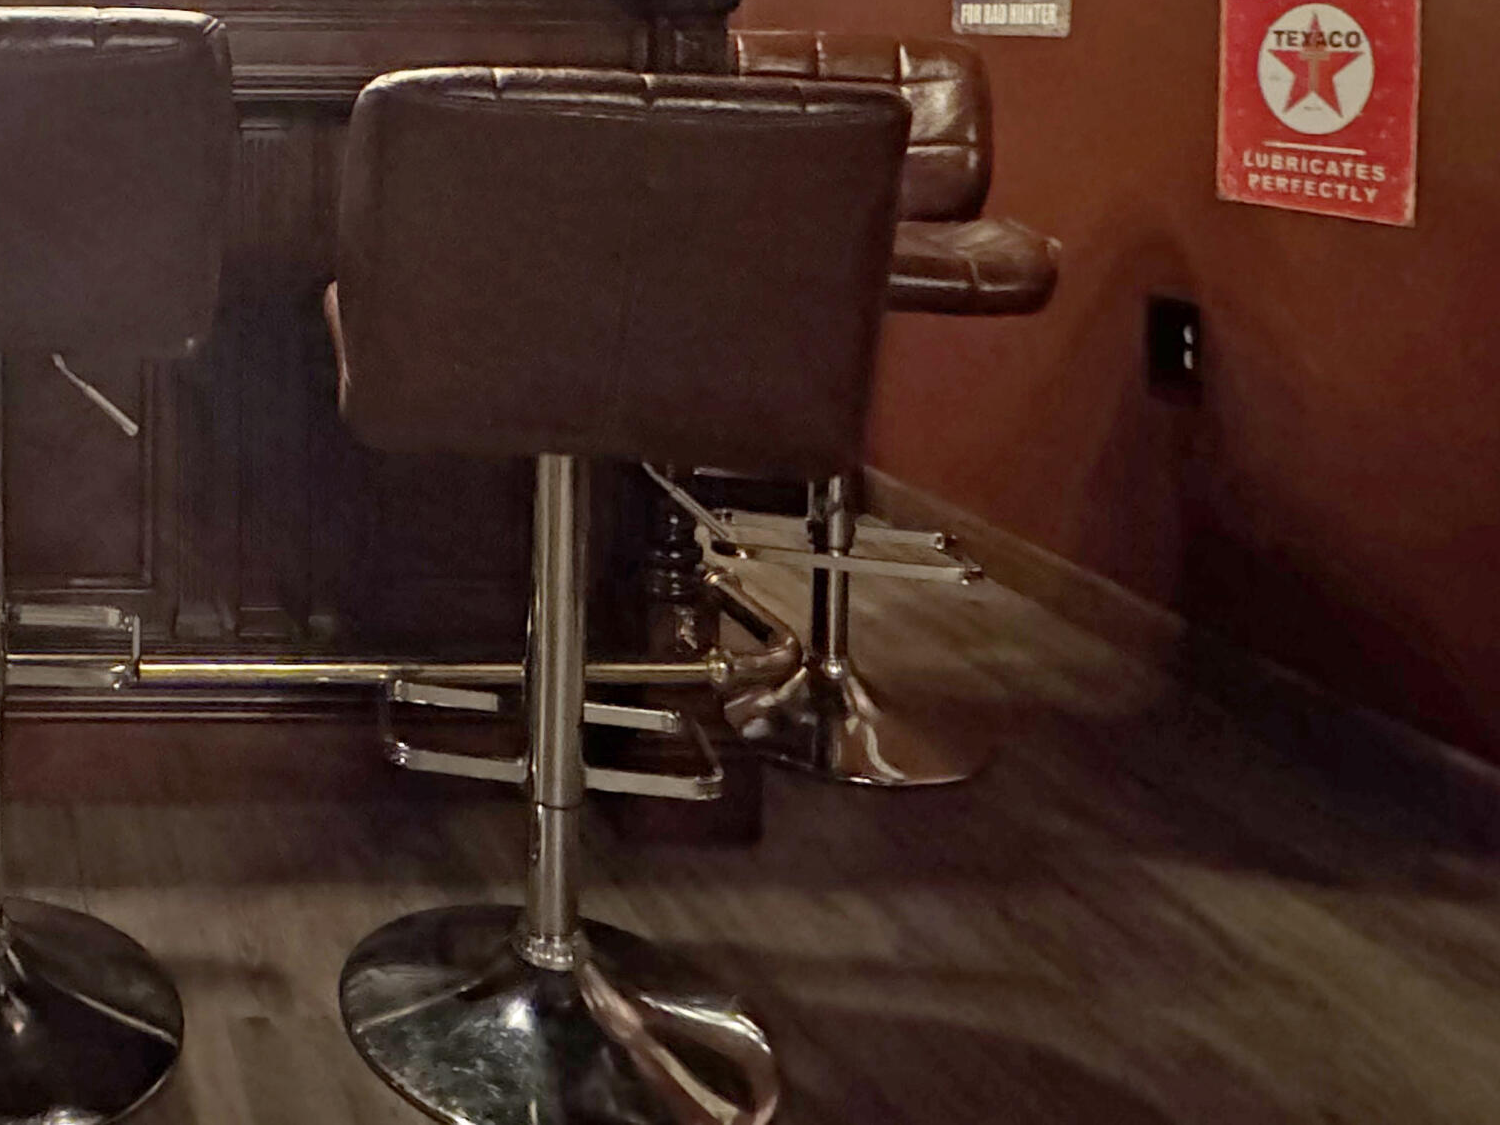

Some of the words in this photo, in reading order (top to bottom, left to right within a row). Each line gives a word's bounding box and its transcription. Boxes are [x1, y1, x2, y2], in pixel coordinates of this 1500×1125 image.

[1273, 28, 1363, 49] TEXACO
[1243, 150, 1387, 183] LUBRICATES
[1248, 173, 1380, 204] PERFECTLY
